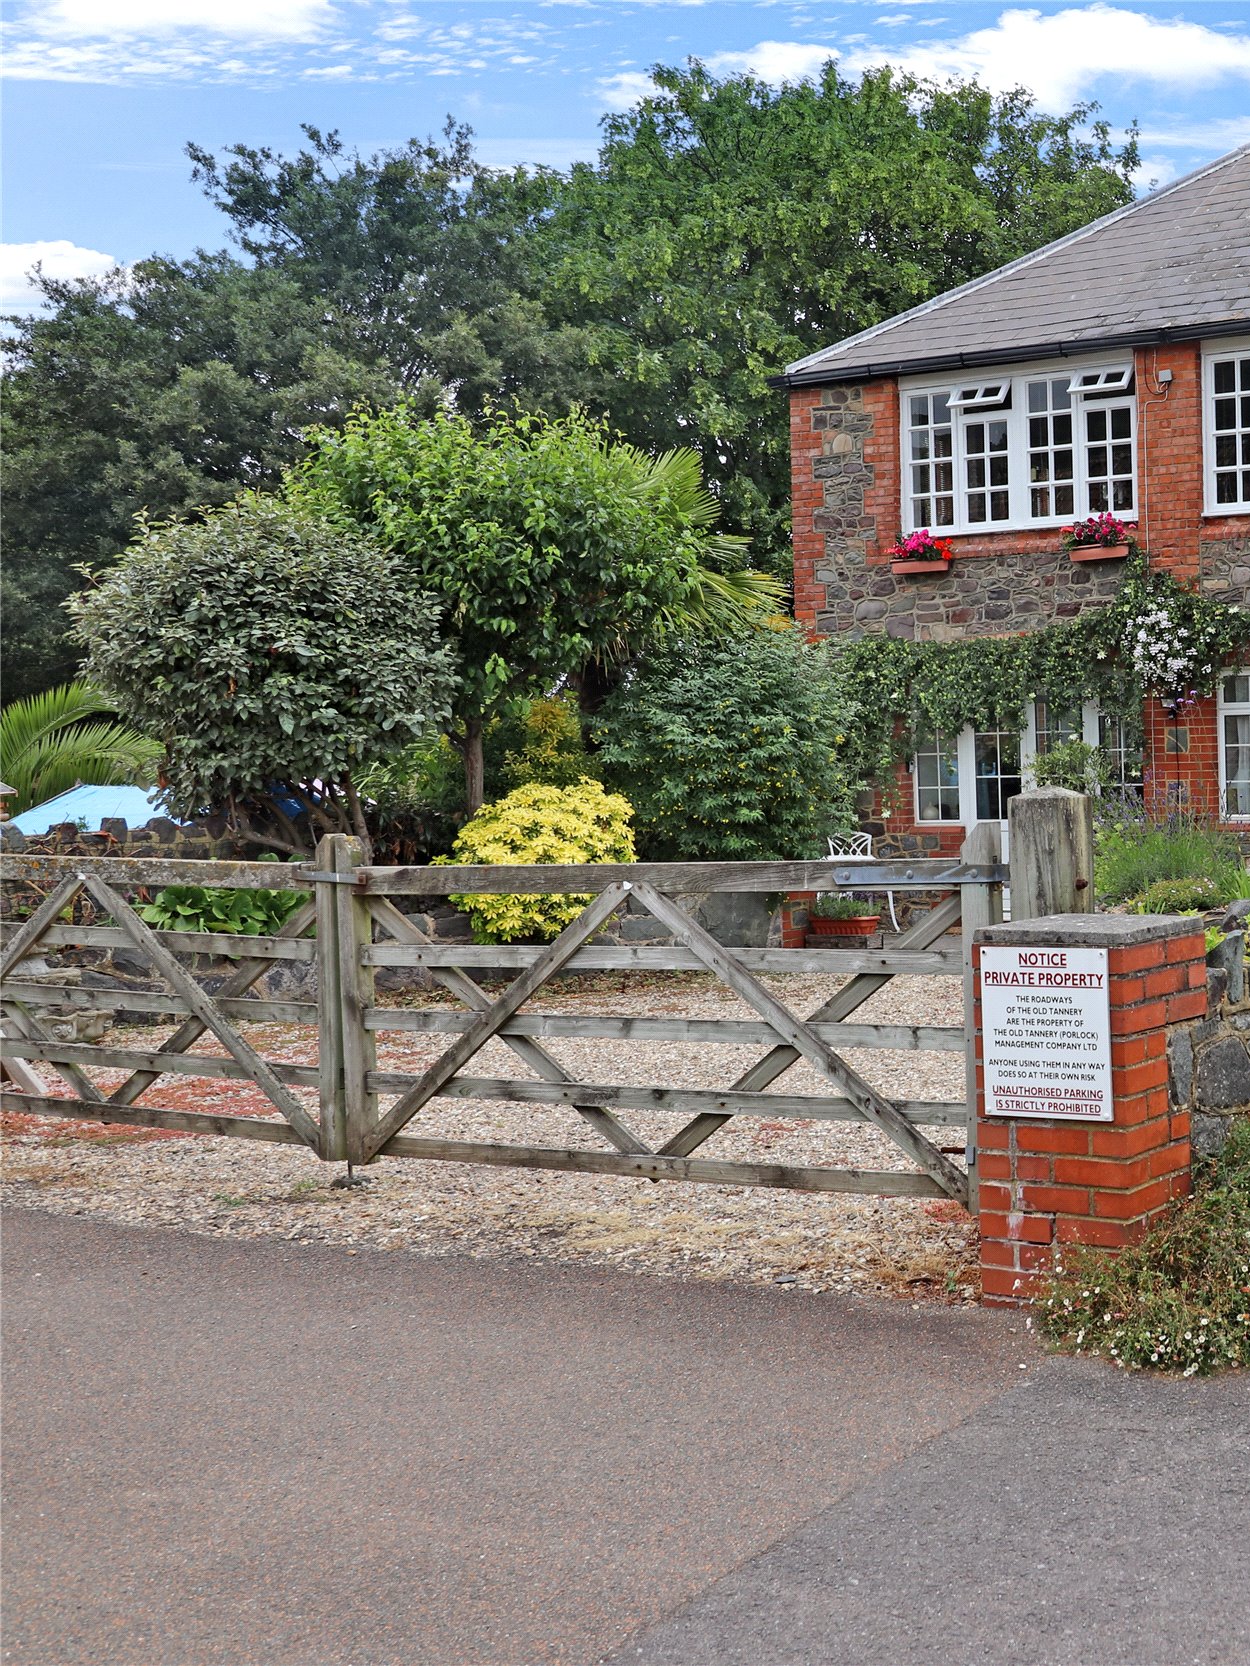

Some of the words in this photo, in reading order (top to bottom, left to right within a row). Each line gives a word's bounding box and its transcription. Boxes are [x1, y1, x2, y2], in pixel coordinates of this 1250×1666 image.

[1019, 953, 1067, 965] NOTICE
[985, 972, 1034, 984] PRIVATE
[1039, 974, 1103, 986] PROPERTY
[1060, 1031, 1098, 1040] (PORLOCK)
[995, 1041, 1043, 1049] MANAGEMENT
[993, 1086, 1062, 1096] UNAUTHORISED
[1064, 1089, 1103, 1099] PARKING
[996, 1100, 1003, 1108] IS
[1005, 1101, 1045, 1110] STRICTLY
[1048, 1103, 1101, 1113] PROHIBITED
